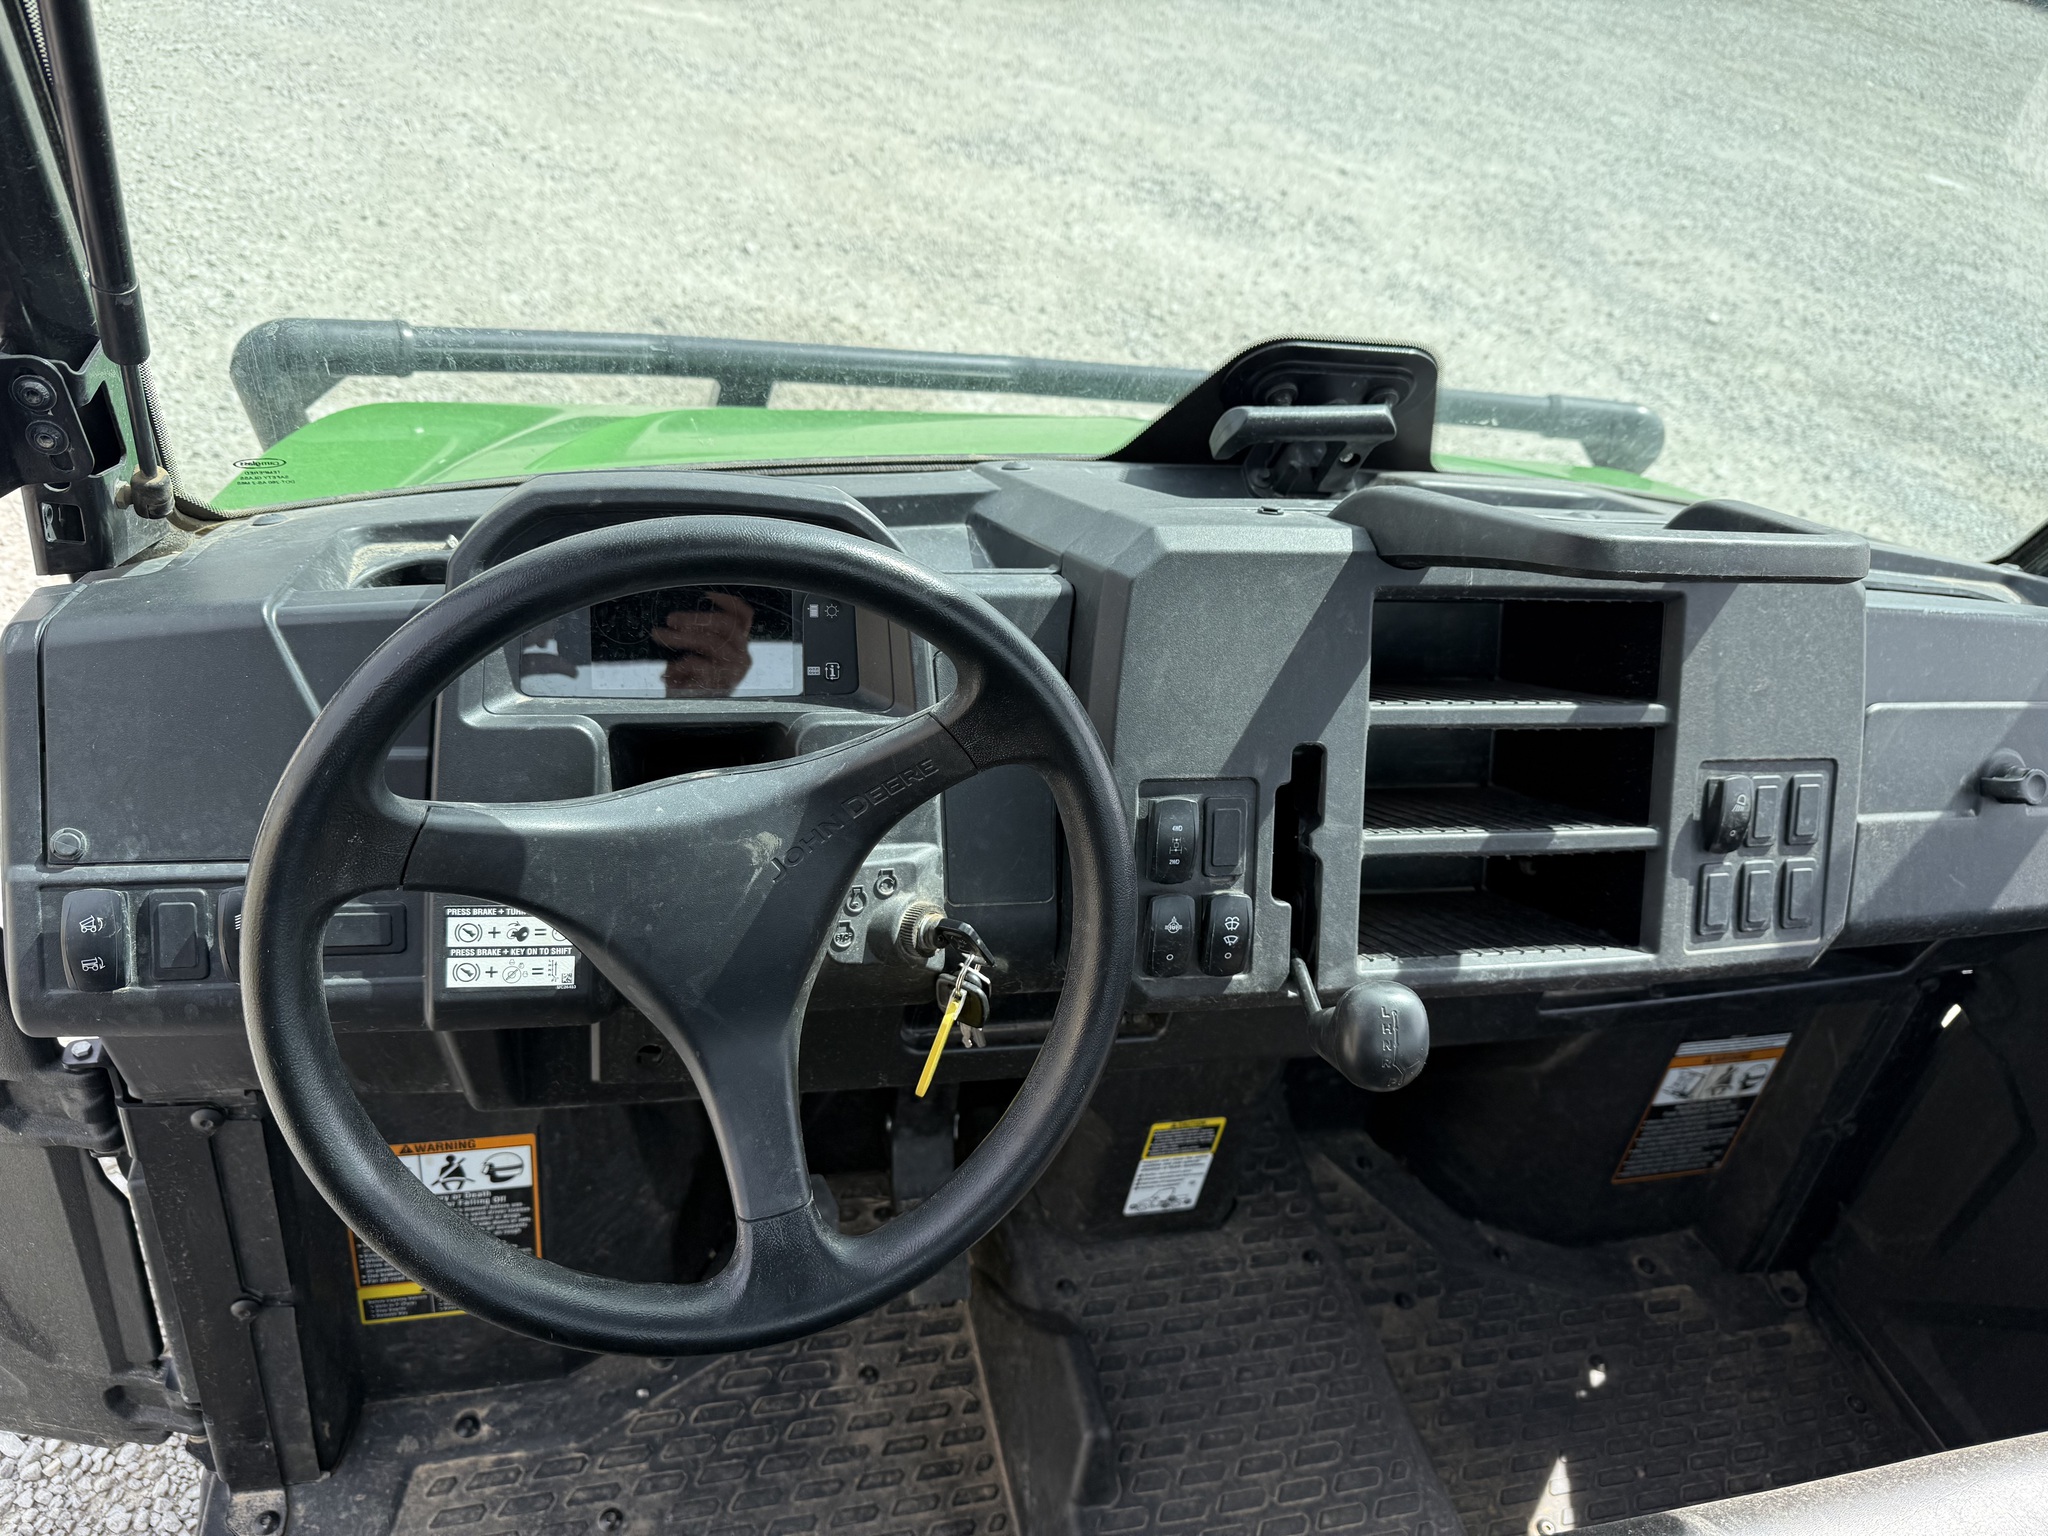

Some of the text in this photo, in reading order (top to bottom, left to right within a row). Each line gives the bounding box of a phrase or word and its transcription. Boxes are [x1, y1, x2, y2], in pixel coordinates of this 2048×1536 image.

[772, 758, 940, 882] JOHN DEERE
[1381, 1006, 1390, 1018] L
[1382, 1024, 1392, 1034] H
[414, 1139, 476, 1152] WARNING
